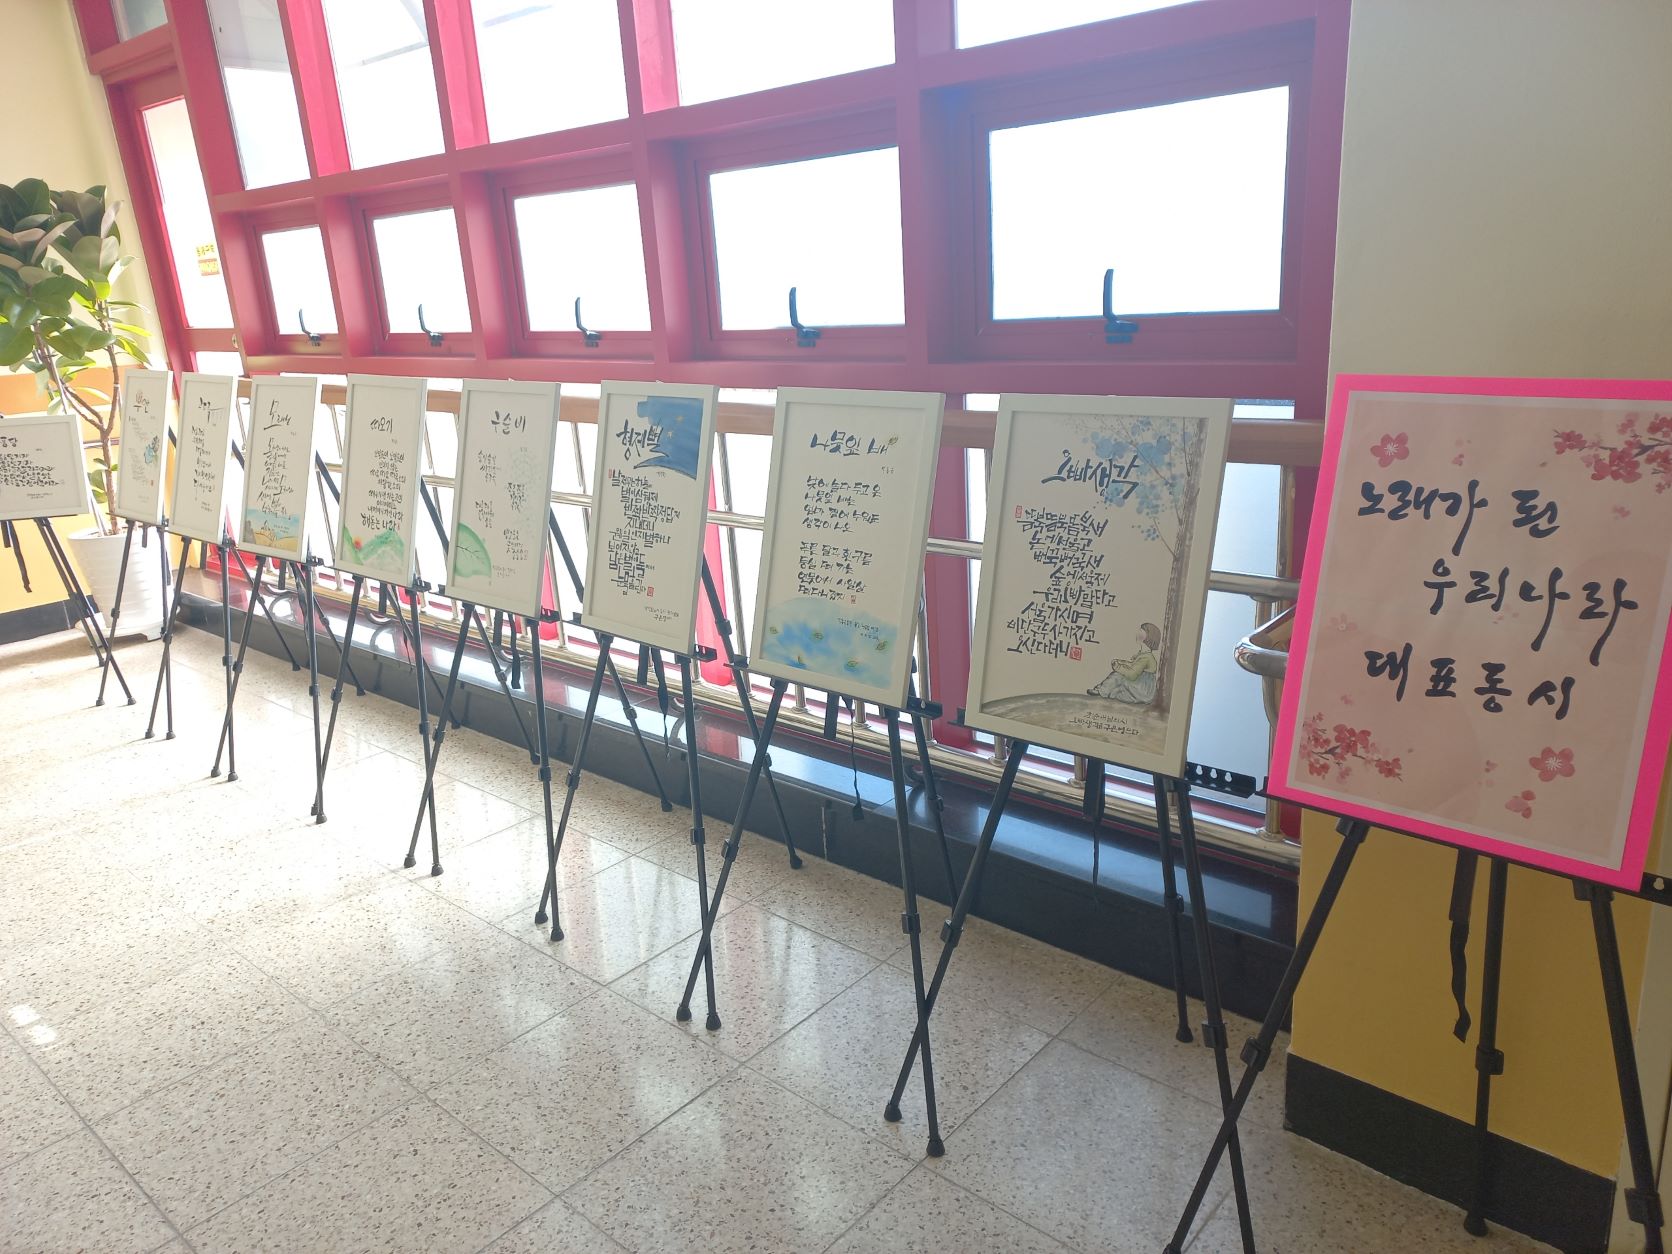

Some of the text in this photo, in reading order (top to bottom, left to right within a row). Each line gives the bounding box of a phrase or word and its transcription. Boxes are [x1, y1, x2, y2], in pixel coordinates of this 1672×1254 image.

[1357, 479, 1561, 556] 노래가 된
[1423, 558, 1638, 666] 우리나라
